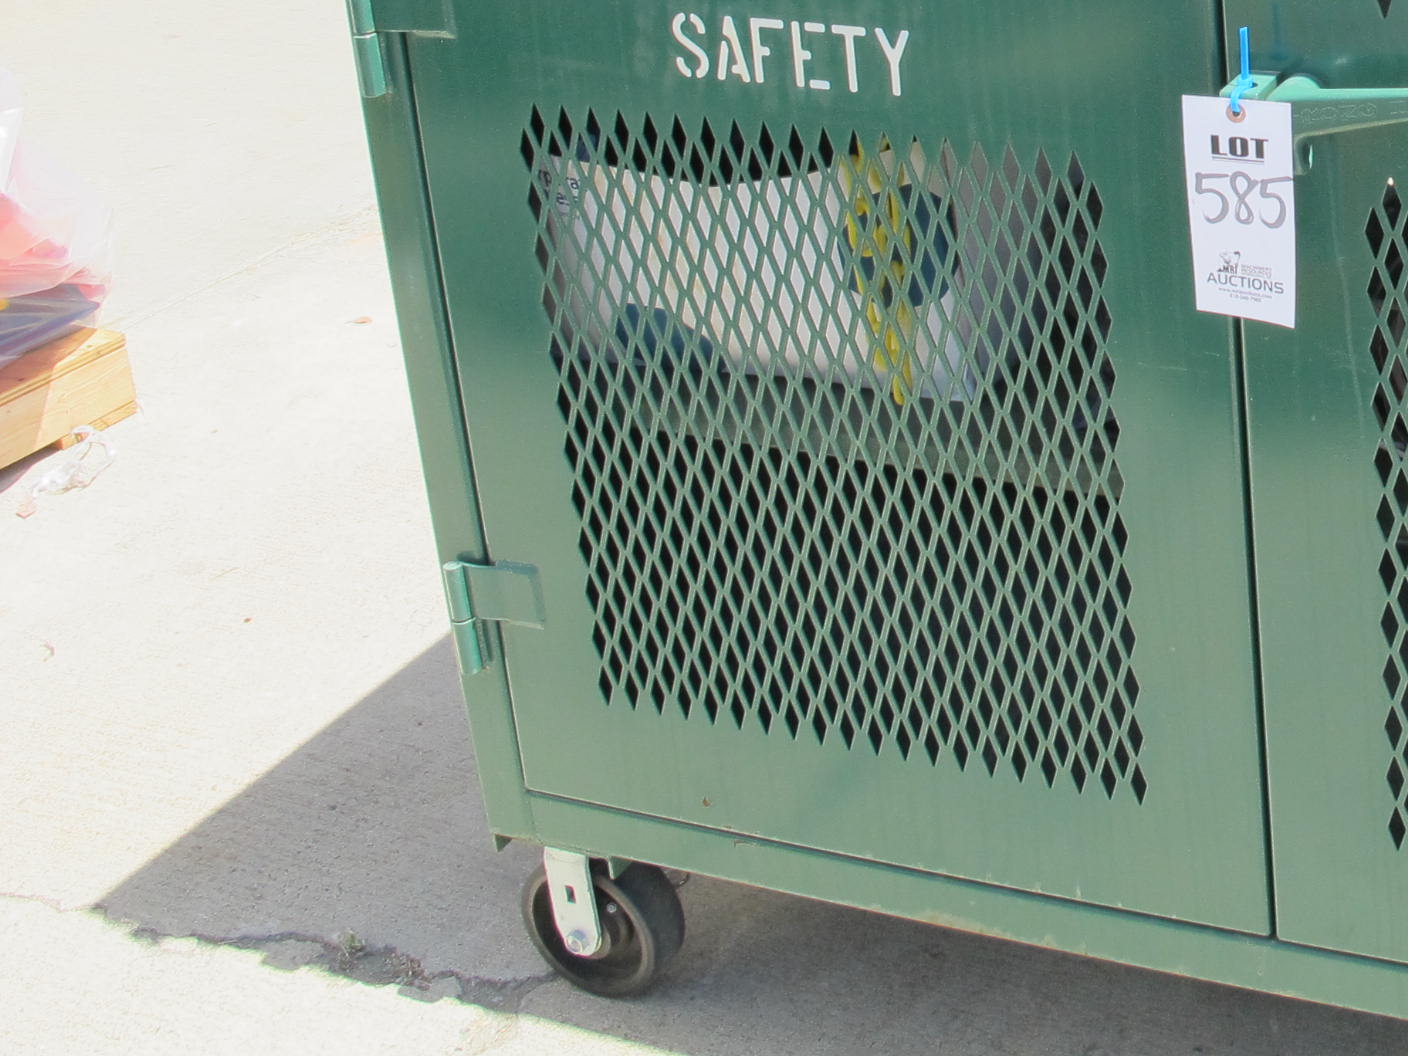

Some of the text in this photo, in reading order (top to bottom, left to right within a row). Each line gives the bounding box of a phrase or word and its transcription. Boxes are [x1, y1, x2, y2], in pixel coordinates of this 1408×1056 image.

[672, 12, 909, 97] SAFETY
[1210, 134, 1269, 159] LOT
[1194, 170, 1295, 229] 585
[1207, 272, 1285, 295] AUCTIONS
